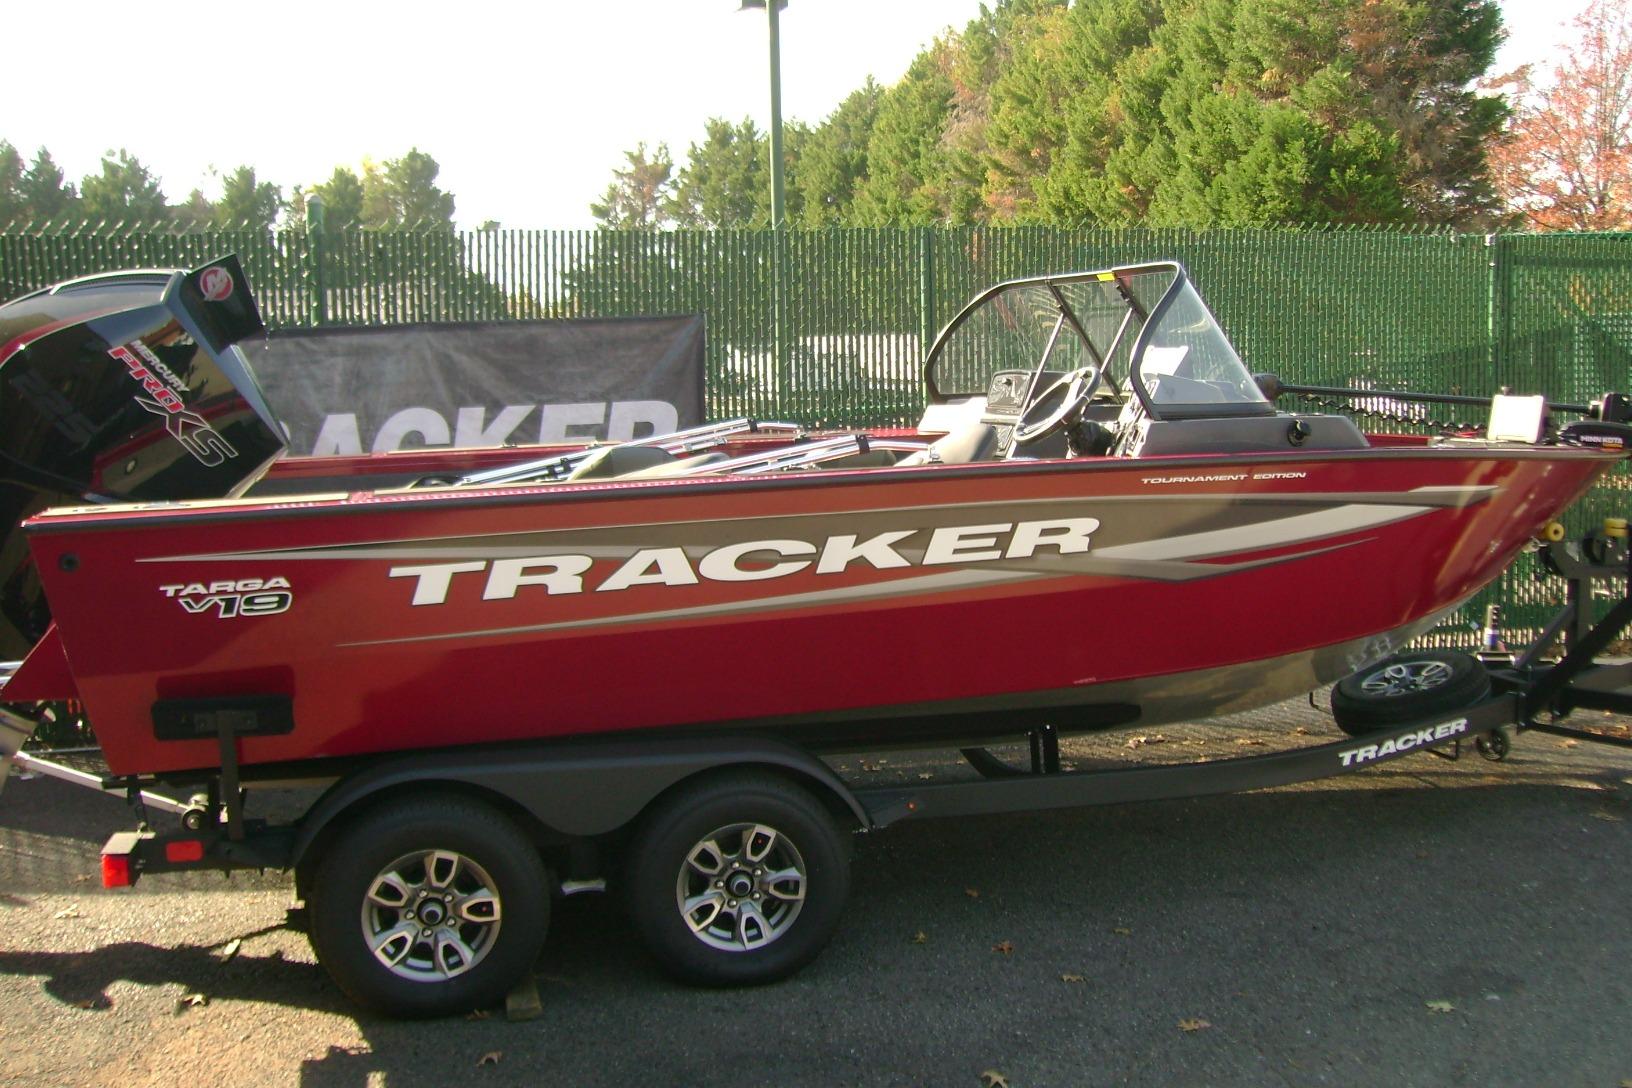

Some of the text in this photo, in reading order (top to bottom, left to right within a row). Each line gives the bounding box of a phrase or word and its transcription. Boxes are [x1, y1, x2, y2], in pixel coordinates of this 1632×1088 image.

[107, 346, 185, 413] PRO
[130, 339, 190, 391] MERCURY
[133, 396, 239, 467] XS
[280, 399, 679, 458] ACKER
[1141, 471, 1307, 484] TOURNAMENT EDITION
[159, 576, 291, 597] TARGA
[388, 517, 1101, 606] TRACKER
[178, 591, 292, 619] V19
[1338, 717, 1468, 767] TRACKER
